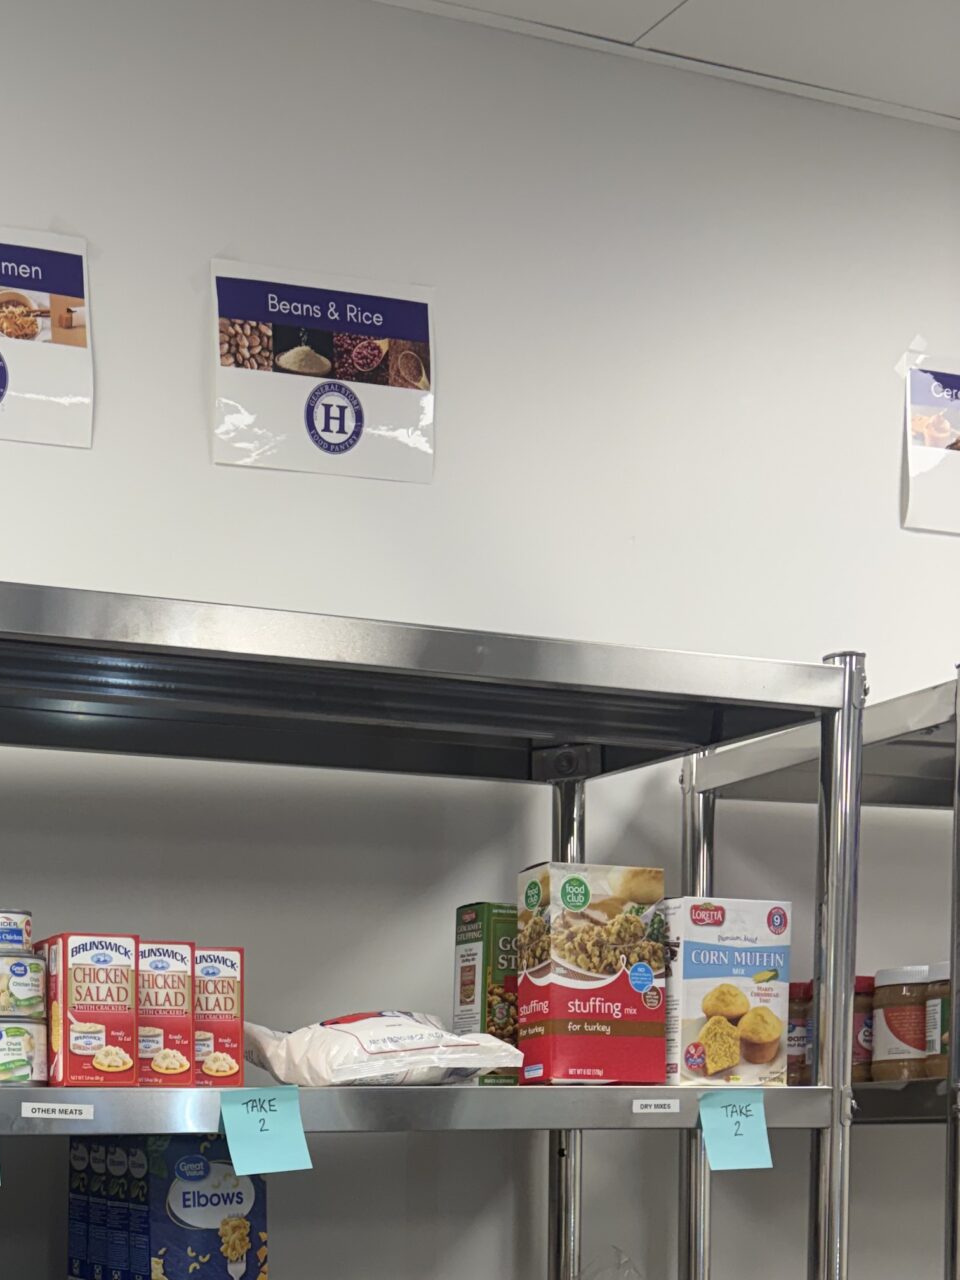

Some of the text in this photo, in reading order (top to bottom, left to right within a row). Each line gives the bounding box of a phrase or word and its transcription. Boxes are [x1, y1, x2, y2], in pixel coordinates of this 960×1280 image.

[268, 294, 383, 325] Beans & Rice
[321, 403, 348, 434] H
[565, 884, 585, 894] food
[566, 893, 585, 903] club
[692, 910, 723, 921] LORETTA
[774, 916, 780, 925] 9
[71, 940, 131, 960] BRUNSWICK
[692, 950, 784, 967] CORN MUFFIN
[73, 967, 129, 984] CHICKEN
[74, 985, 128, 1002] SALAD
[519, 1000, 549, 1016] stuffing
[568, 998, 637, 1018] stuffing mix
[568, 1022, 611, 1034] for turkey
[241, 1098, 277, 1114] TAKE
[721, 1104, 753, 1118] TAKE
[259, 1118, 269, 1132] 2
[734, 1121, 744, 1137] 2
[182, 1191, 244, 1209] Elbows
